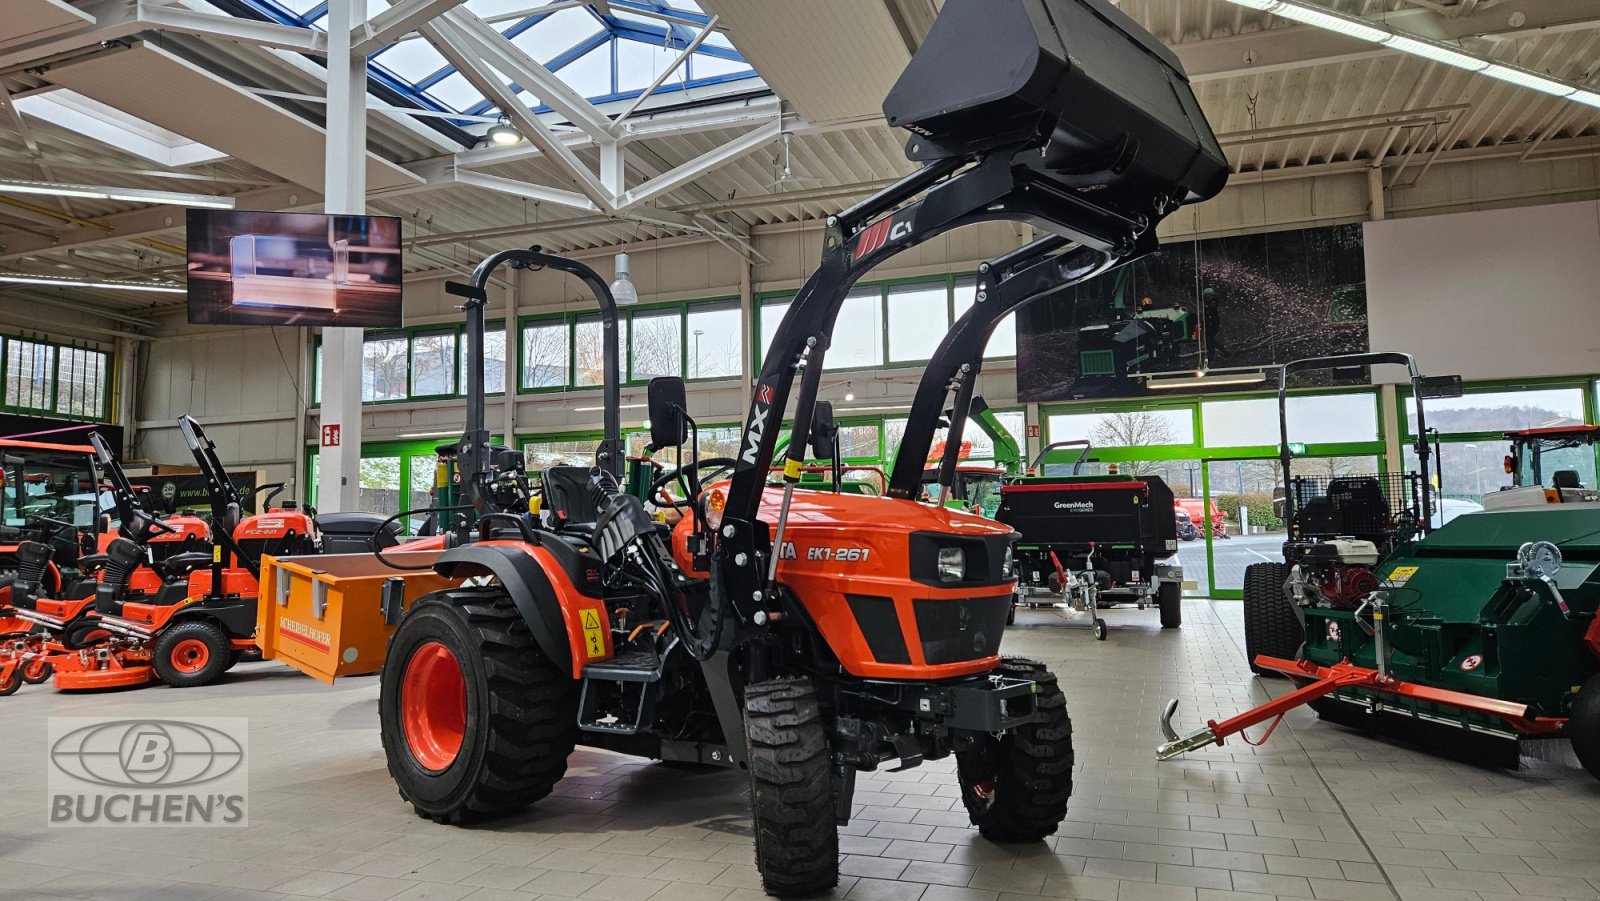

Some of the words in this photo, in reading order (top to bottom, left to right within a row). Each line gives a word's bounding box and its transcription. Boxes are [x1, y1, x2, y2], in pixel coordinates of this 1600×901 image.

[889, 221, 913, 241] C1
[742, 403, 769, 465] MX
[1053, 501, 1094, 509] GreenMech
[807, 547, 870, 562] EK1-261
[279, 616, 331, 644] SCHEIBELHOFER
